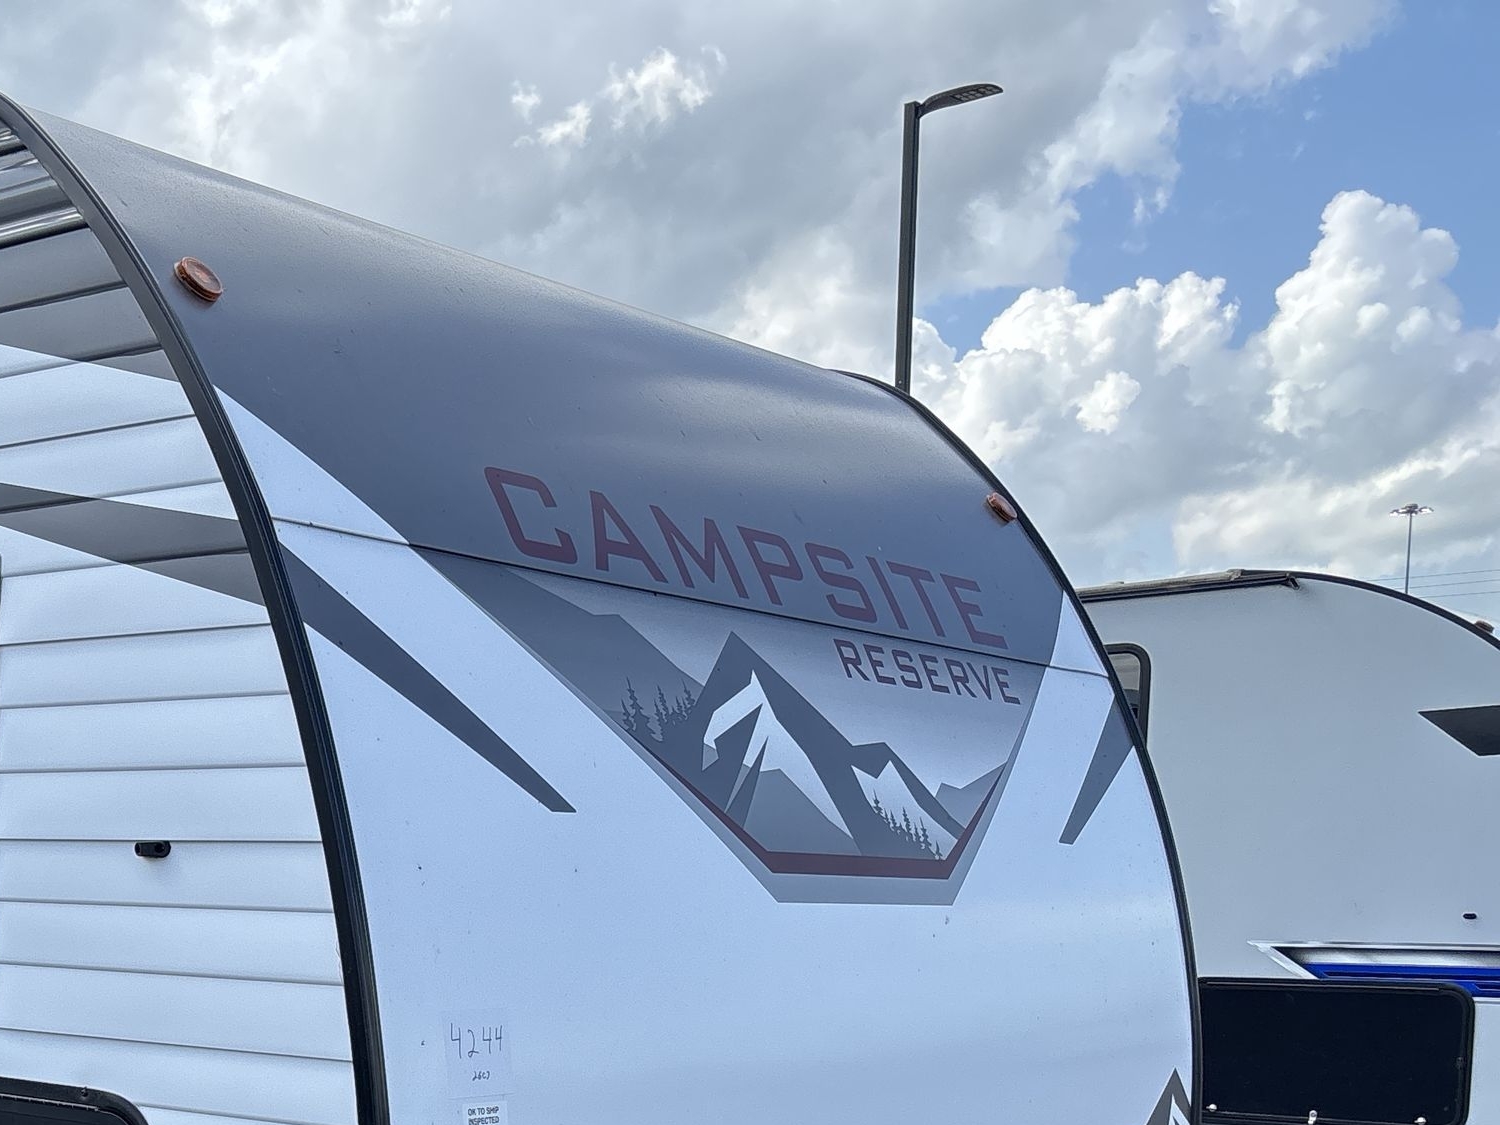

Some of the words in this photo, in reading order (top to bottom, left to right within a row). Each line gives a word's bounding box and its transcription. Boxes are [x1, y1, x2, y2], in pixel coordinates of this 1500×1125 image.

[483, 465, 1008, 650] CAMPSITE
[832, 637, 1022, 706] RESERVE
[450, 1022, 503, 1059] 4244
[467, 1108, 476, 1116] OK
[477, 1107, 485, 1115] TO
[486, 1106, 499, 1114] SHIP
[468, 1116, 500, 1125] INSPECTED
